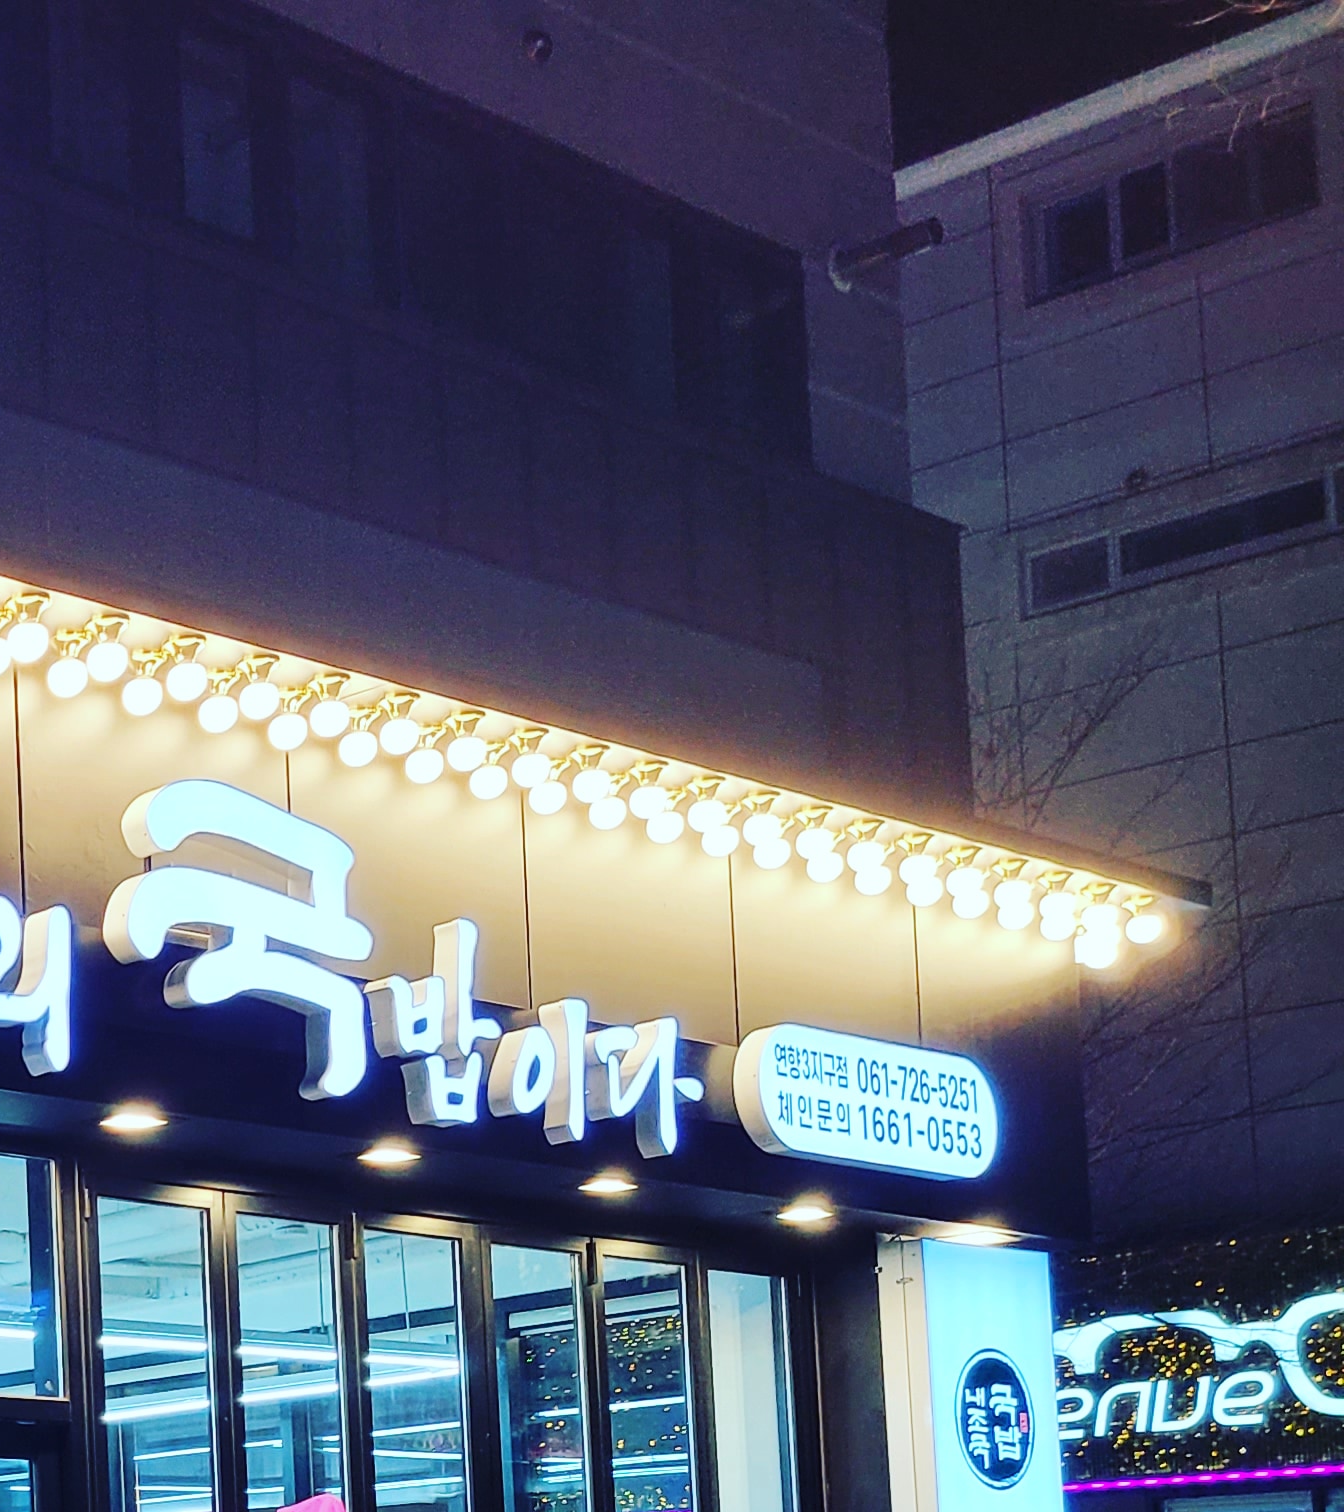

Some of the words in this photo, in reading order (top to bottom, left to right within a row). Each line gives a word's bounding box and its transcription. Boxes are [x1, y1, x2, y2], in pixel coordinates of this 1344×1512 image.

[103, 778, 703, 1158] 국밥이다
[774, 1043, 849, 1088] 연향3지구점
[857, 1057, 978, 1114] 061-726-5251
[858, 1105, 982, 1159] 1661-0553
[965, 1387, 991, 1470] 내조국
[989, 1383, 1022, 1461] 국밥
